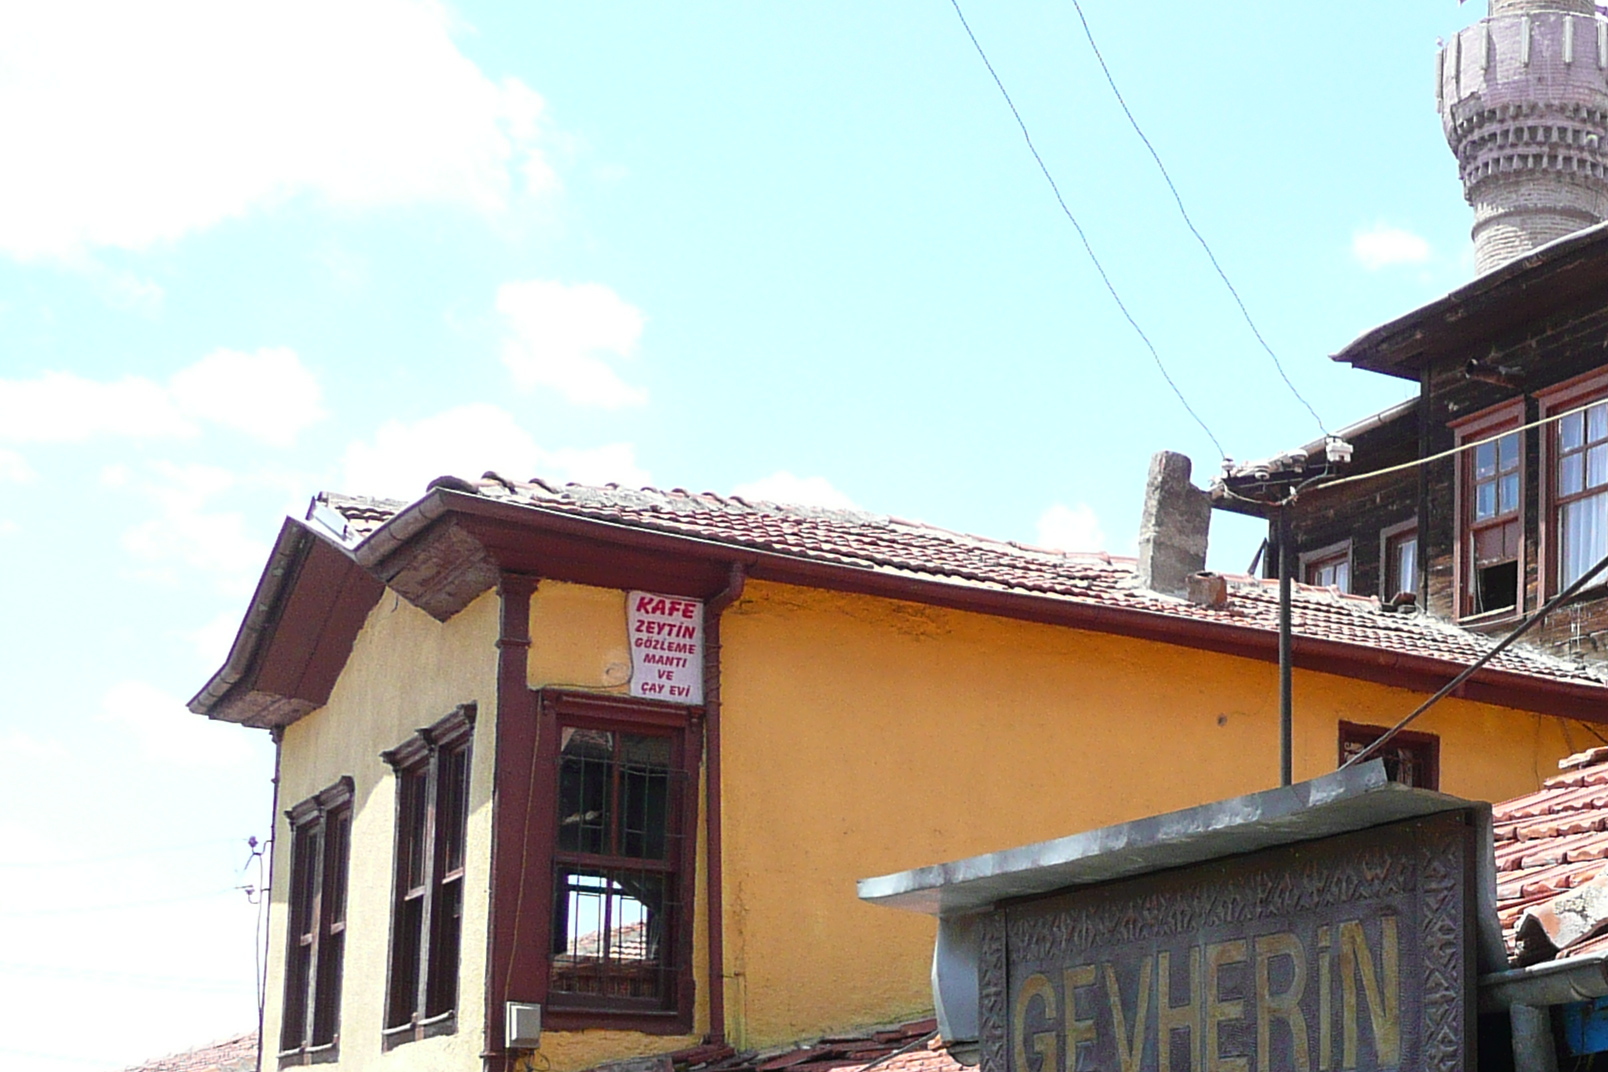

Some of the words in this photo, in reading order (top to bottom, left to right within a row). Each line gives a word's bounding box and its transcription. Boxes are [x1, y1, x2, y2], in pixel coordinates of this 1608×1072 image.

[636, 596, 696, 619] KAFE
[635, 619, 696, 639] ZEYTİN
[635, 636, 696, 654] GÖZLEME
[643, 653, 688, 668] MANTI
[657, 669, 674, 680] VE
[641, 682, 665, 694] ÇAY
[669, 685, 691, 697] EVİ
